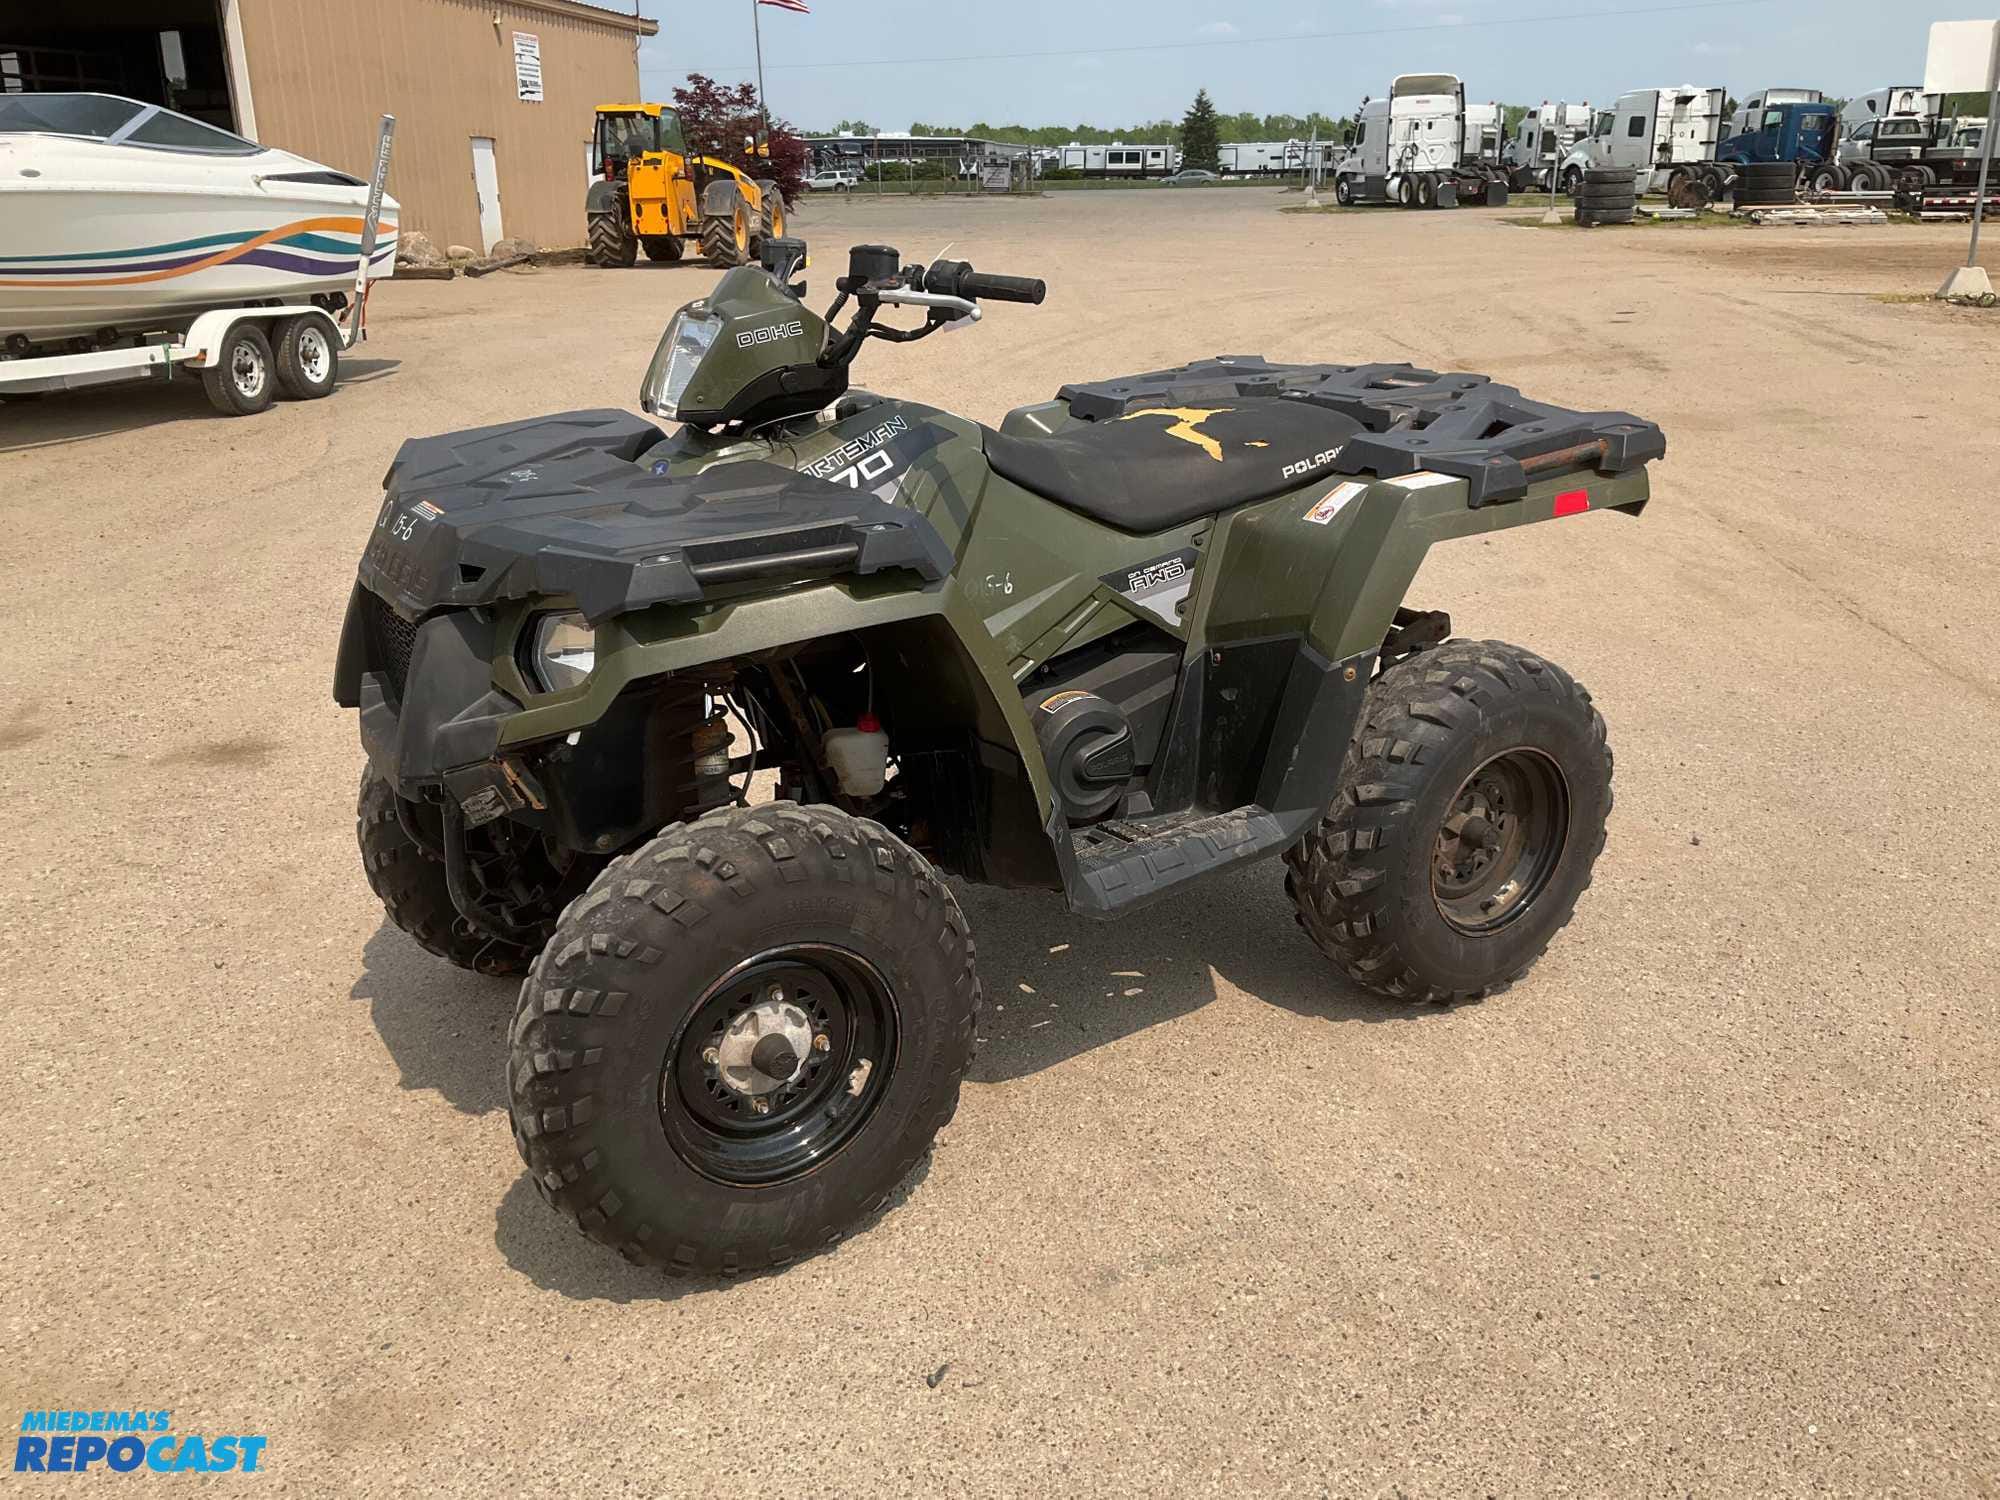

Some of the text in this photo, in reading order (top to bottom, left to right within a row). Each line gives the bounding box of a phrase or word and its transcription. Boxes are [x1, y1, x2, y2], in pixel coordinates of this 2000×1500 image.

[736, 320, 804, 348] DOHC
[799, 414, 909, 478] RTSMAN
[1129, 562, 1186, 593] AWD
